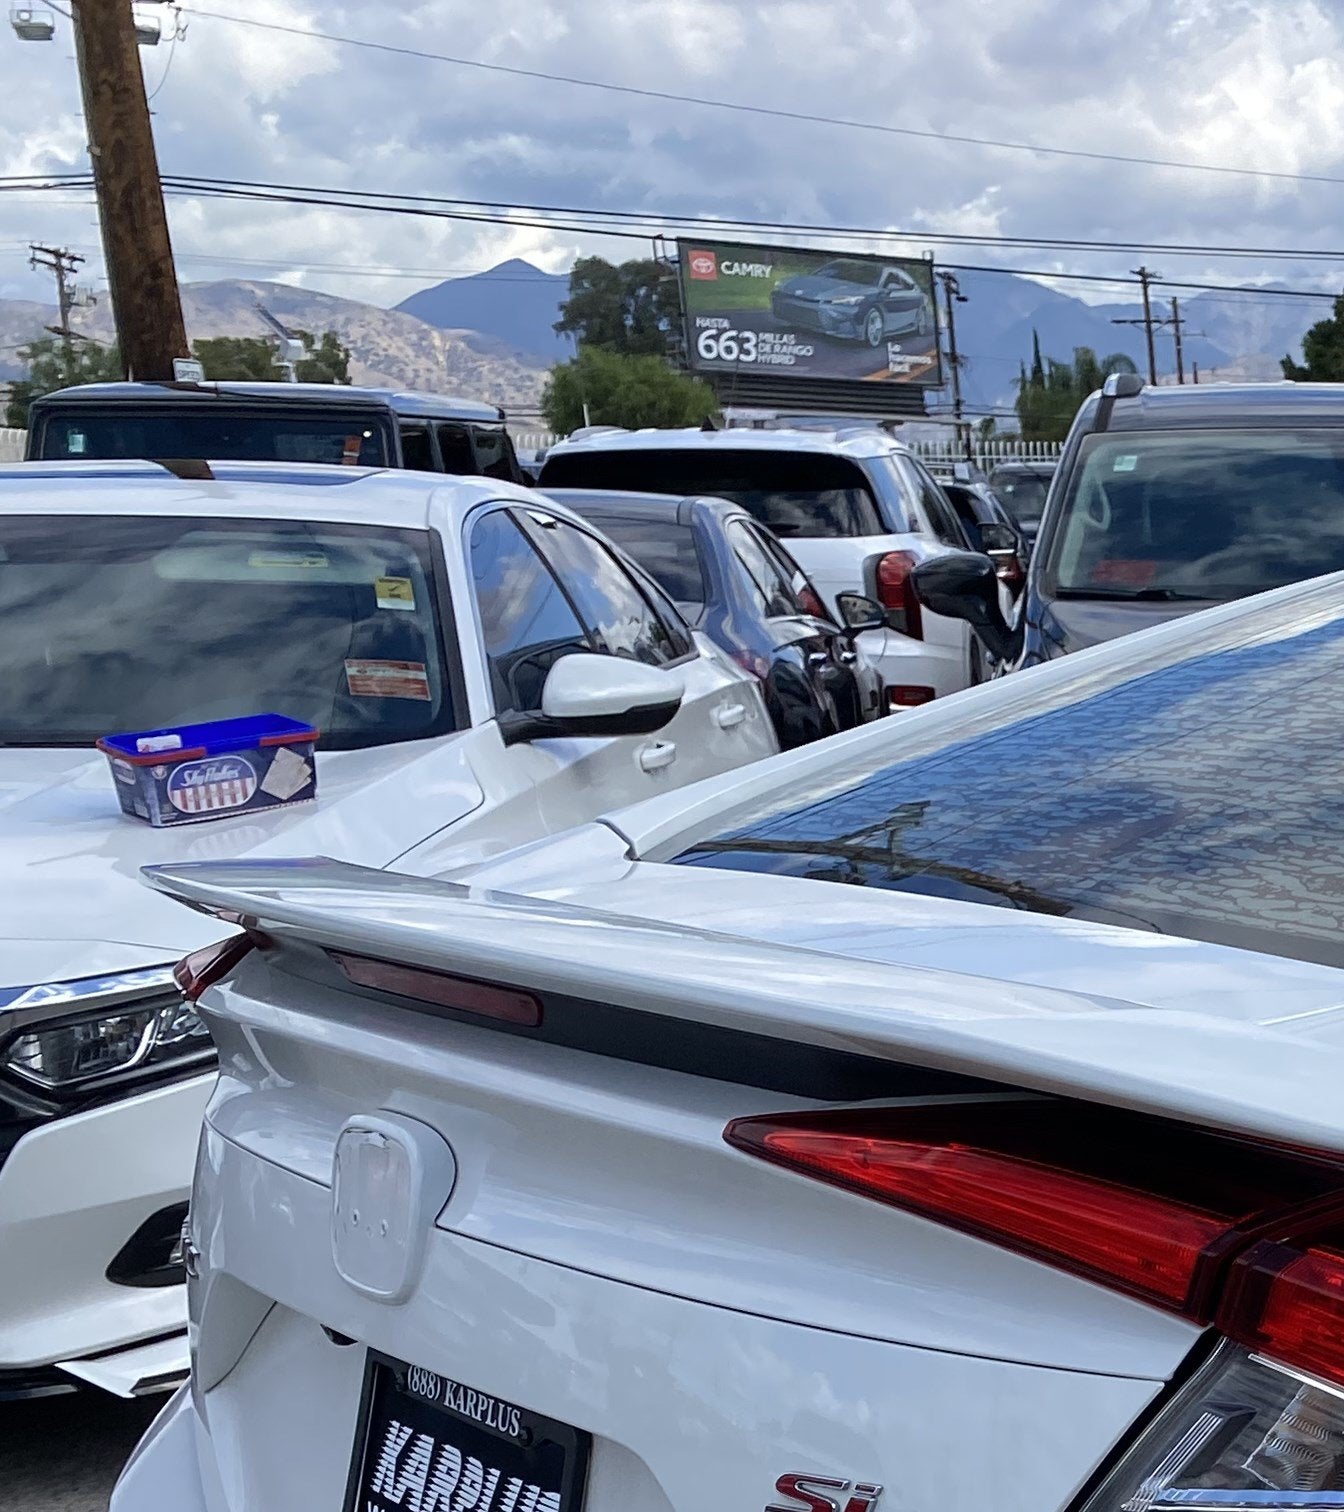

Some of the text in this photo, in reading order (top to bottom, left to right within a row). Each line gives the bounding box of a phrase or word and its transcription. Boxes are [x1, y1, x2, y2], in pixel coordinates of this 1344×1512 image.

[720, 261, 773, 278] CAMRY
[696, 317, 732, 330] HASTA
[697, 329, 758, 362] 663
[758, 333, 797, 346] MILLAS
[758, 343, 814, 357] DE RANGO
[407, 1364, 522, 1437] (888) KARPLUS
